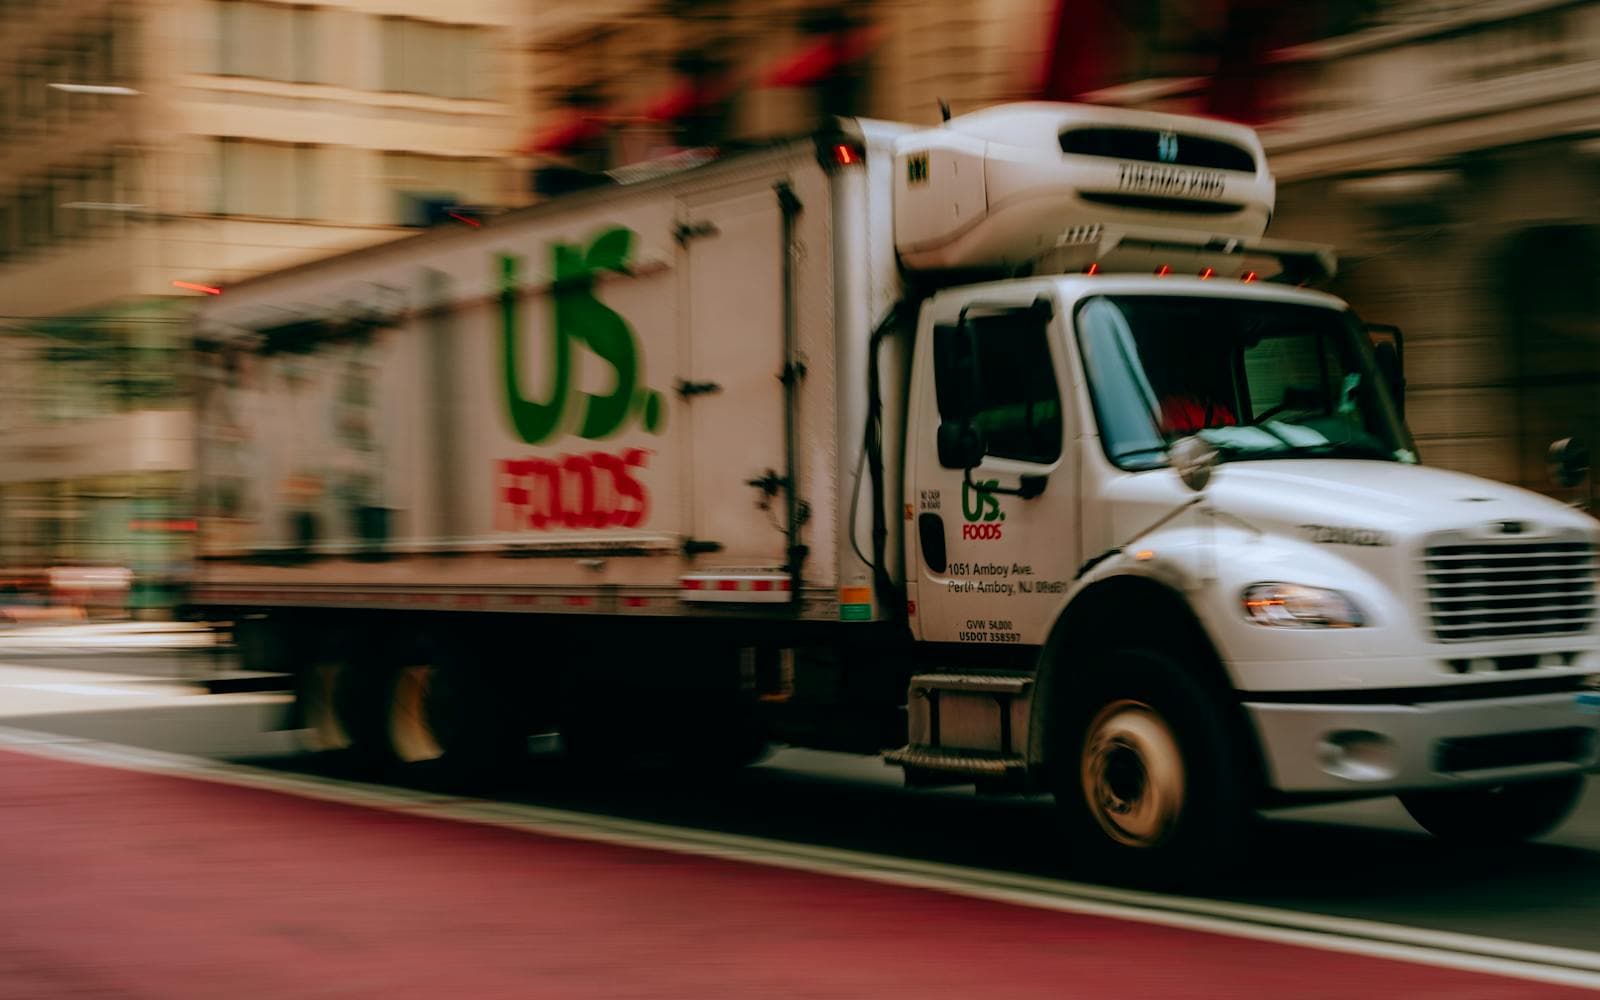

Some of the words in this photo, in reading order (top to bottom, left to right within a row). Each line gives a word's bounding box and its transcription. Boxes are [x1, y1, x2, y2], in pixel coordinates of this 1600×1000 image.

[496, 450, 647, 529] FOODS
[963, 523, 1003, 540] FOODS
[948, 563, 970, 575] 1051
[973, 563, 1008, 578] Amboy
[1012, 563, 1034, 575] Ave.
[948, 580, 974, 593] Perth
[1019, 581, 1032, 593] NJ
[966, 619, 986, 630] GVW
[959, 631, 987, 641] USDOT
